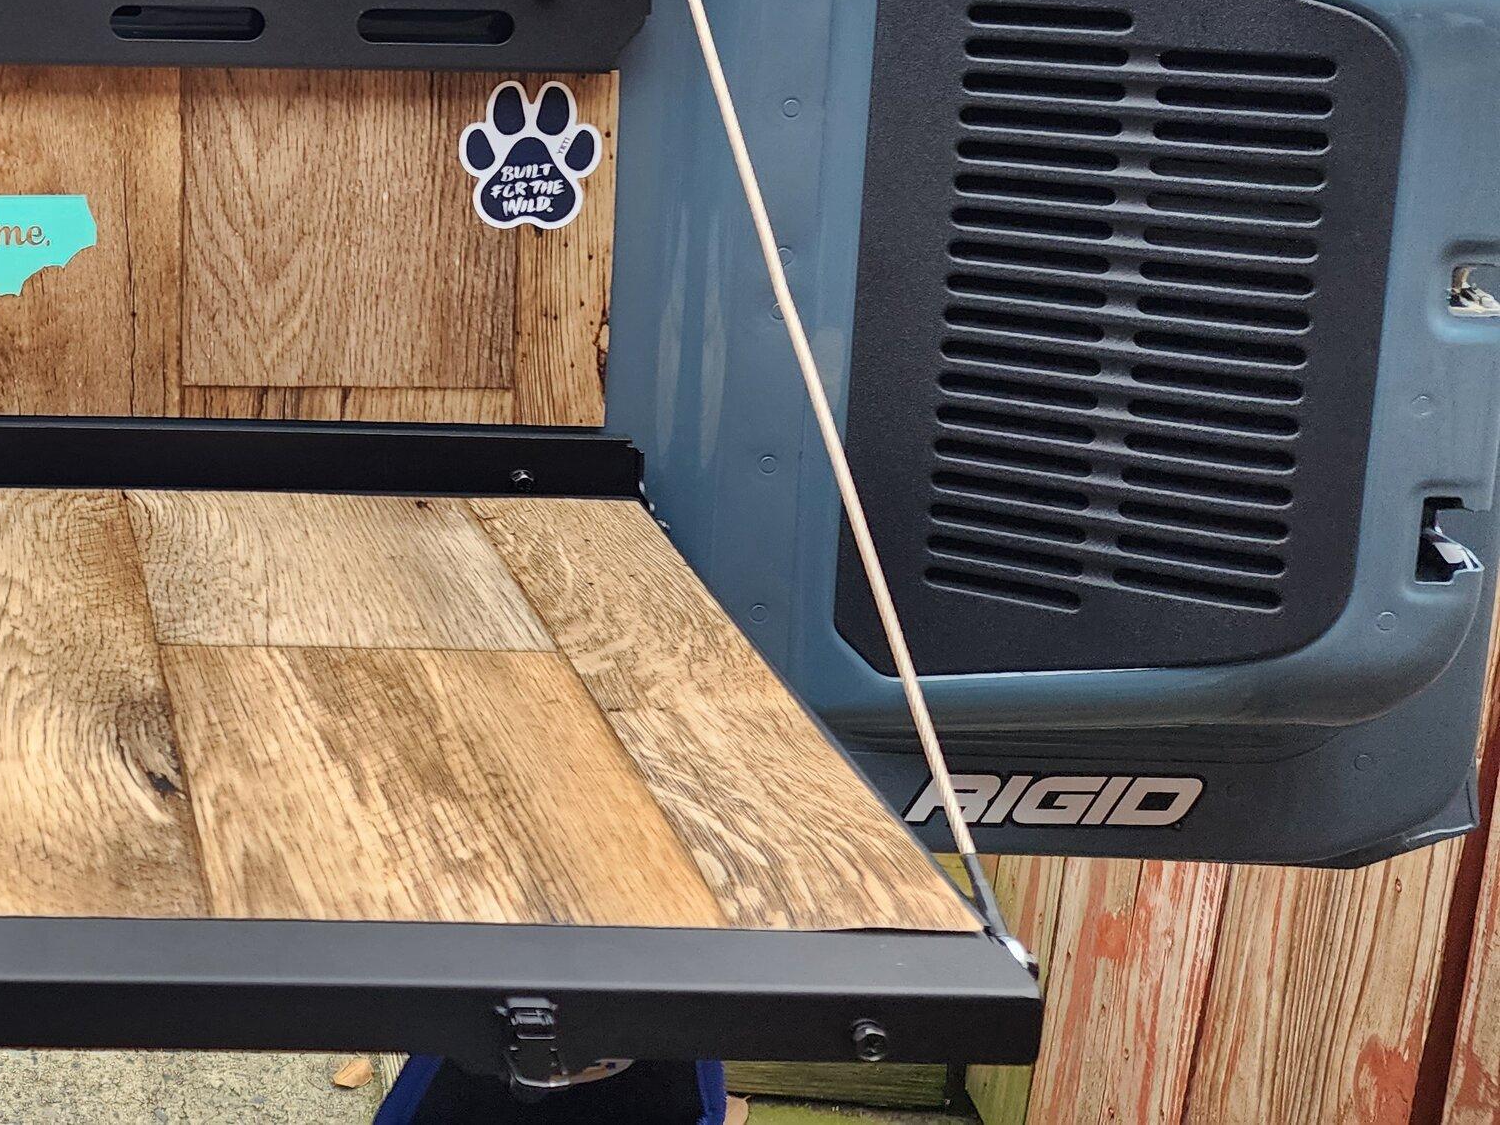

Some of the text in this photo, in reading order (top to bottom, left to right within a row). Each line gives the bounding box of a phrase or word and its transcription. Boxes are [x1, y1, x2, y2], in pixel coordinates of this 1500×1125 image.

[500, 162, 554, 183] BUILT
[529, 178, 566, 196] THE
[502, 195, 554, 217] WILD.
[903, 774, 1204, 826] RIGID
